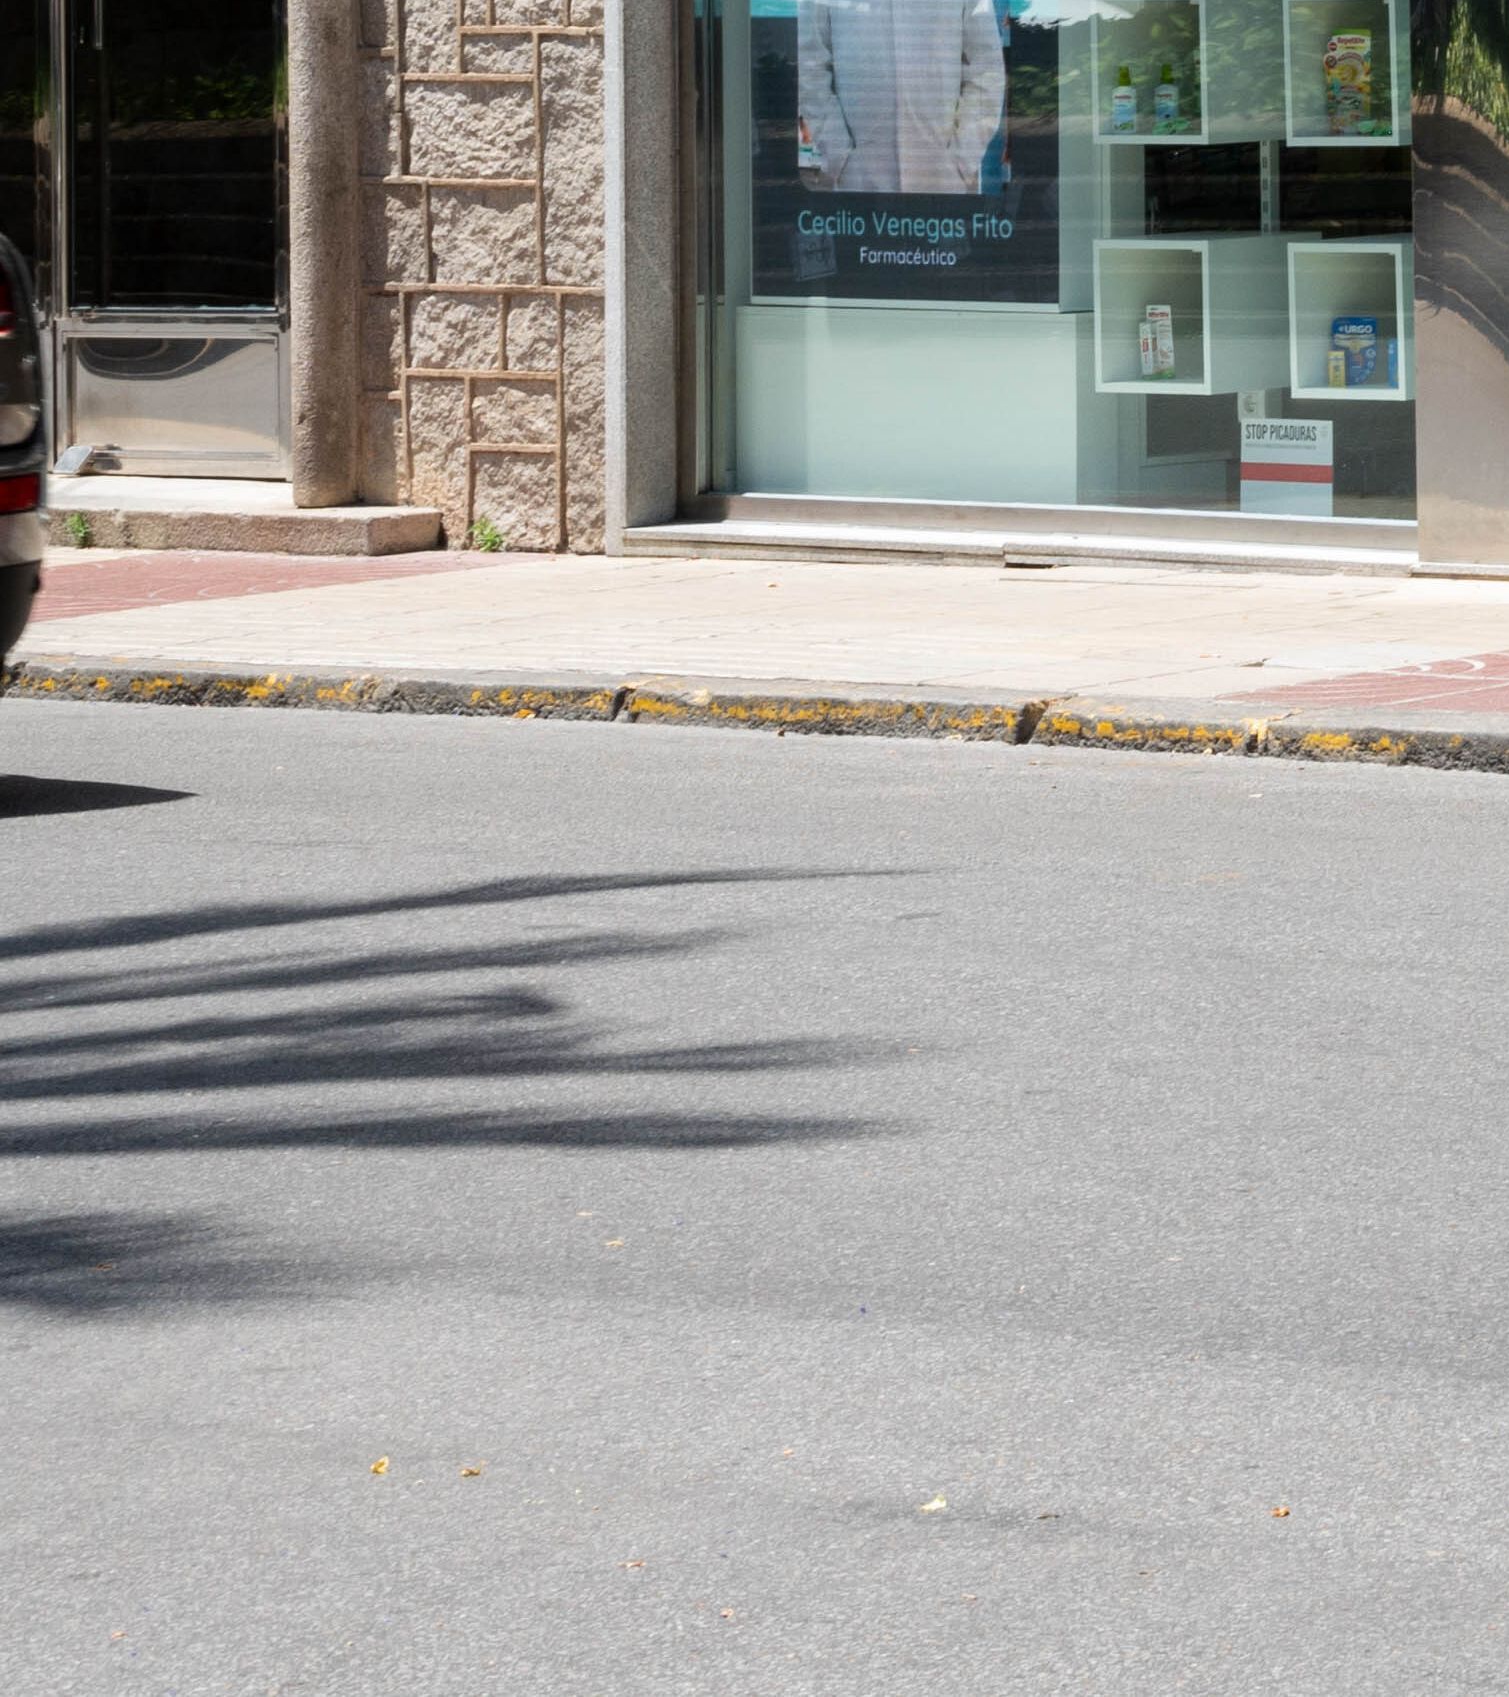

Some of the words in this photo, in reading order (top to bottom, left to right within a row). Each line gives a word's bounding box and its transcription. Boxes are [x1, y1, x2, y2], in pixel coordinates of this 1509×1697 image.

[798, 209, 866, 236] Cecilio
[871, 211, 966, 244] Venegas
[972, 213, 1014, 239] Fito
[859, 246, 957, 266] Farmacéutico
[1345, 324, 1373, 334] URGO
[1245, 424, 1269, 440] STOP
[1269, 425, 1318, 442] PICADURAS
